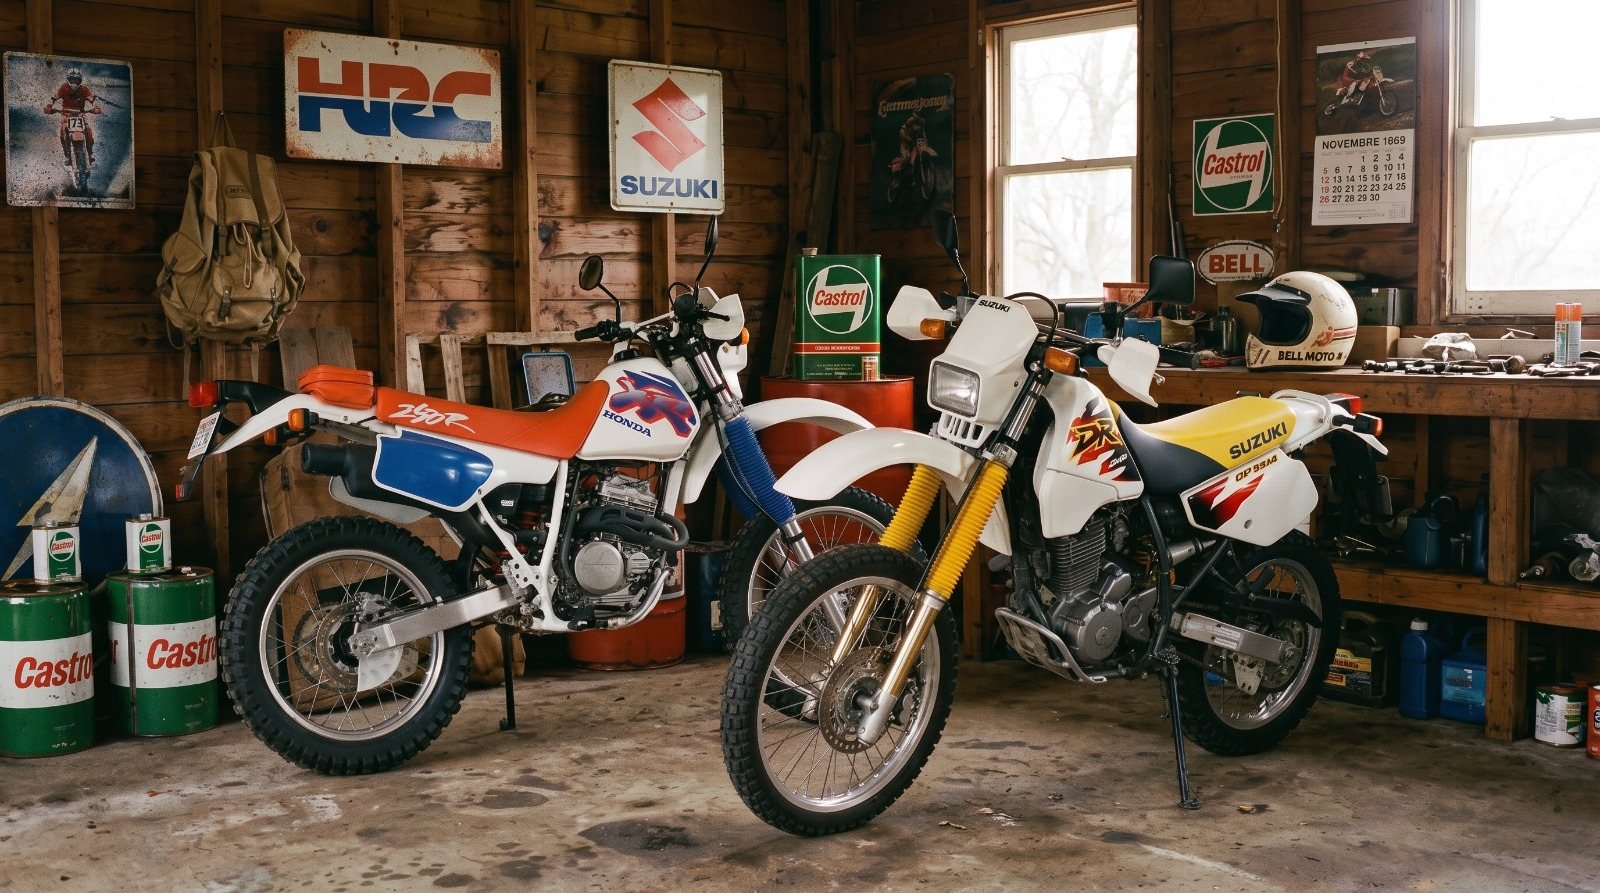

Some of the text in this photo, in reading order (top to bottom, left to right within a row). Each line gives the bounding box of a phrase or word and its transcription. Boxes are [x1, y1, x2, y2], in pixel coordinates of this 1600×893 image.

[298, 56, 491, 143] HRC
[1322, 138, 1379, 149] NOVEMBRE
[1204, 151, 1264, 176] Castrol
[1373, 154, 1379, 162] 2
[1386, 153, 1391, 161] 3
[1335, 166, 1340, 174] 6
[620, 175, 718, 199] SUZUKI
[1345, 185, 1354, 193] 21
[1370, 184, 1380, 192] 23
[1383, 183, 1393, 191] 24
[1332, 195, 1342, 203] 27
[1358, 194, 1367, 202] 29
[1370, 193, 1380, 201] 30
[1209, 254, 1264, 274] BELL
[815, 289, 865, 306] Castrol
[979, 299, 1010, 313] SUZUKI
[1278, 351, 1303, 361] BELL
[1305, 352, 1335, 362] MOTO
[603, 410, 652, 438] HONDA
[1069, 418, 1123, 461] DR
[1229, 421, 1288, 460] SUZUKI
[51, 540, 74, 551] Castrol
[14, 651, 93, 689] Castro
